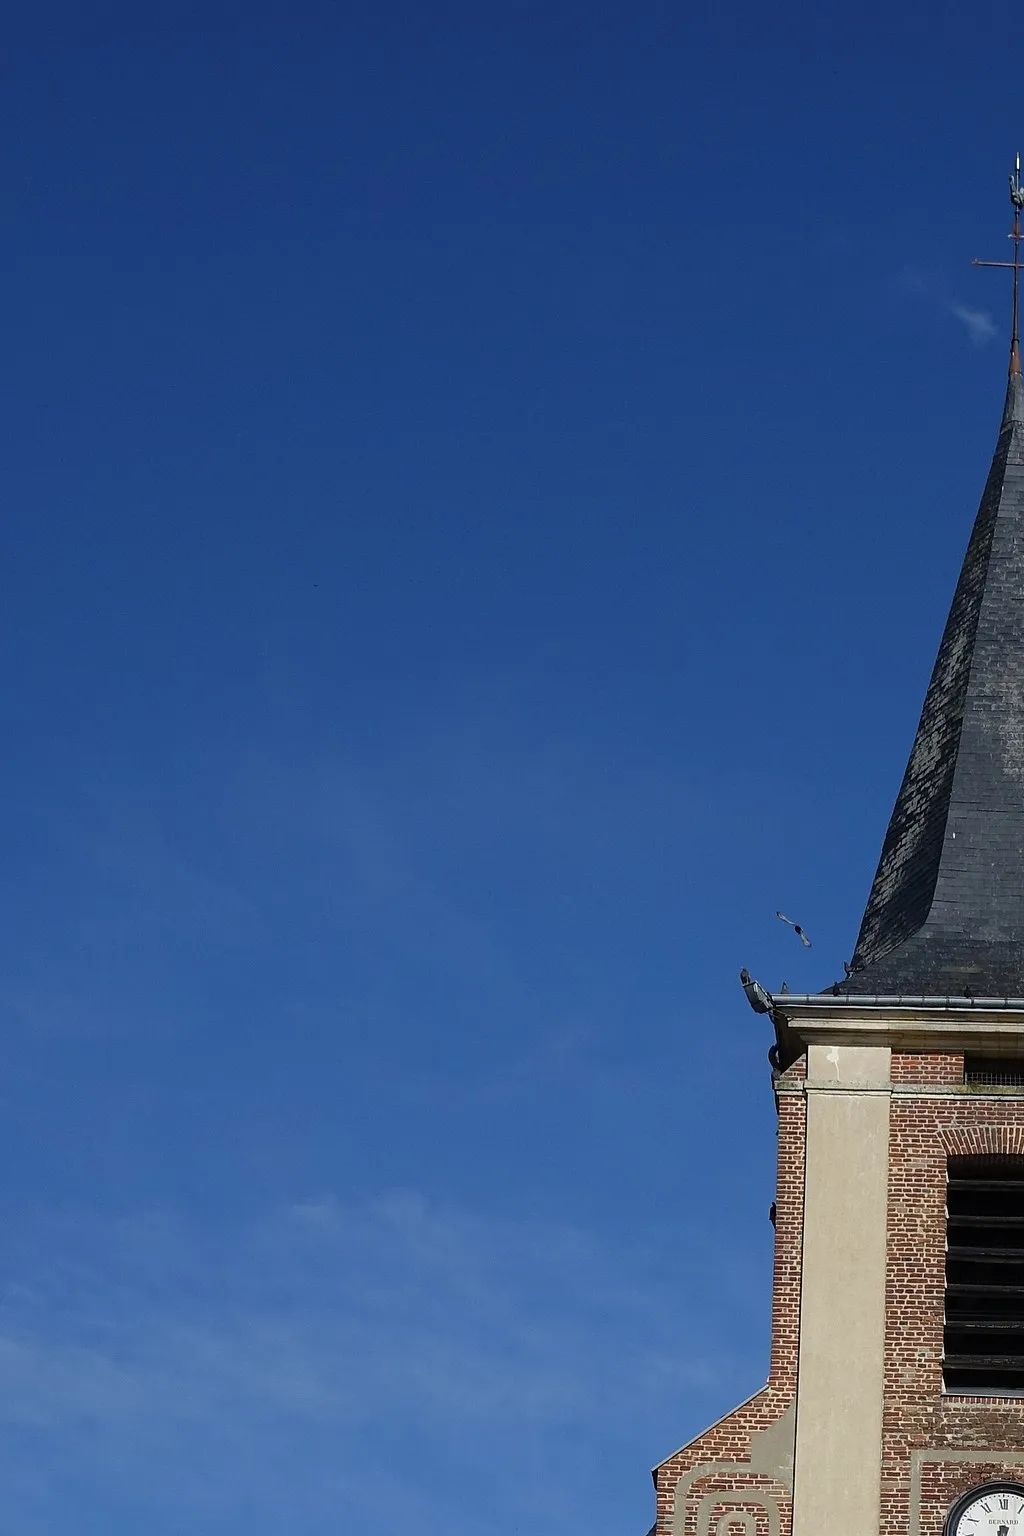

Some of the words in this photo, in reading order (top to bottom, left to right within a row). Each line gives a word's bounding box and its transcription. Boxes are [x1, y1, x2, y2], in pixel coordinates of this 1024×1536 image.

[981, 1502, 992, 1515] XI
[999, 1499, 1009, 1510] XII
[1017, 1504, 1024, 1514] I
[966, 1515, 980, 1526] X
